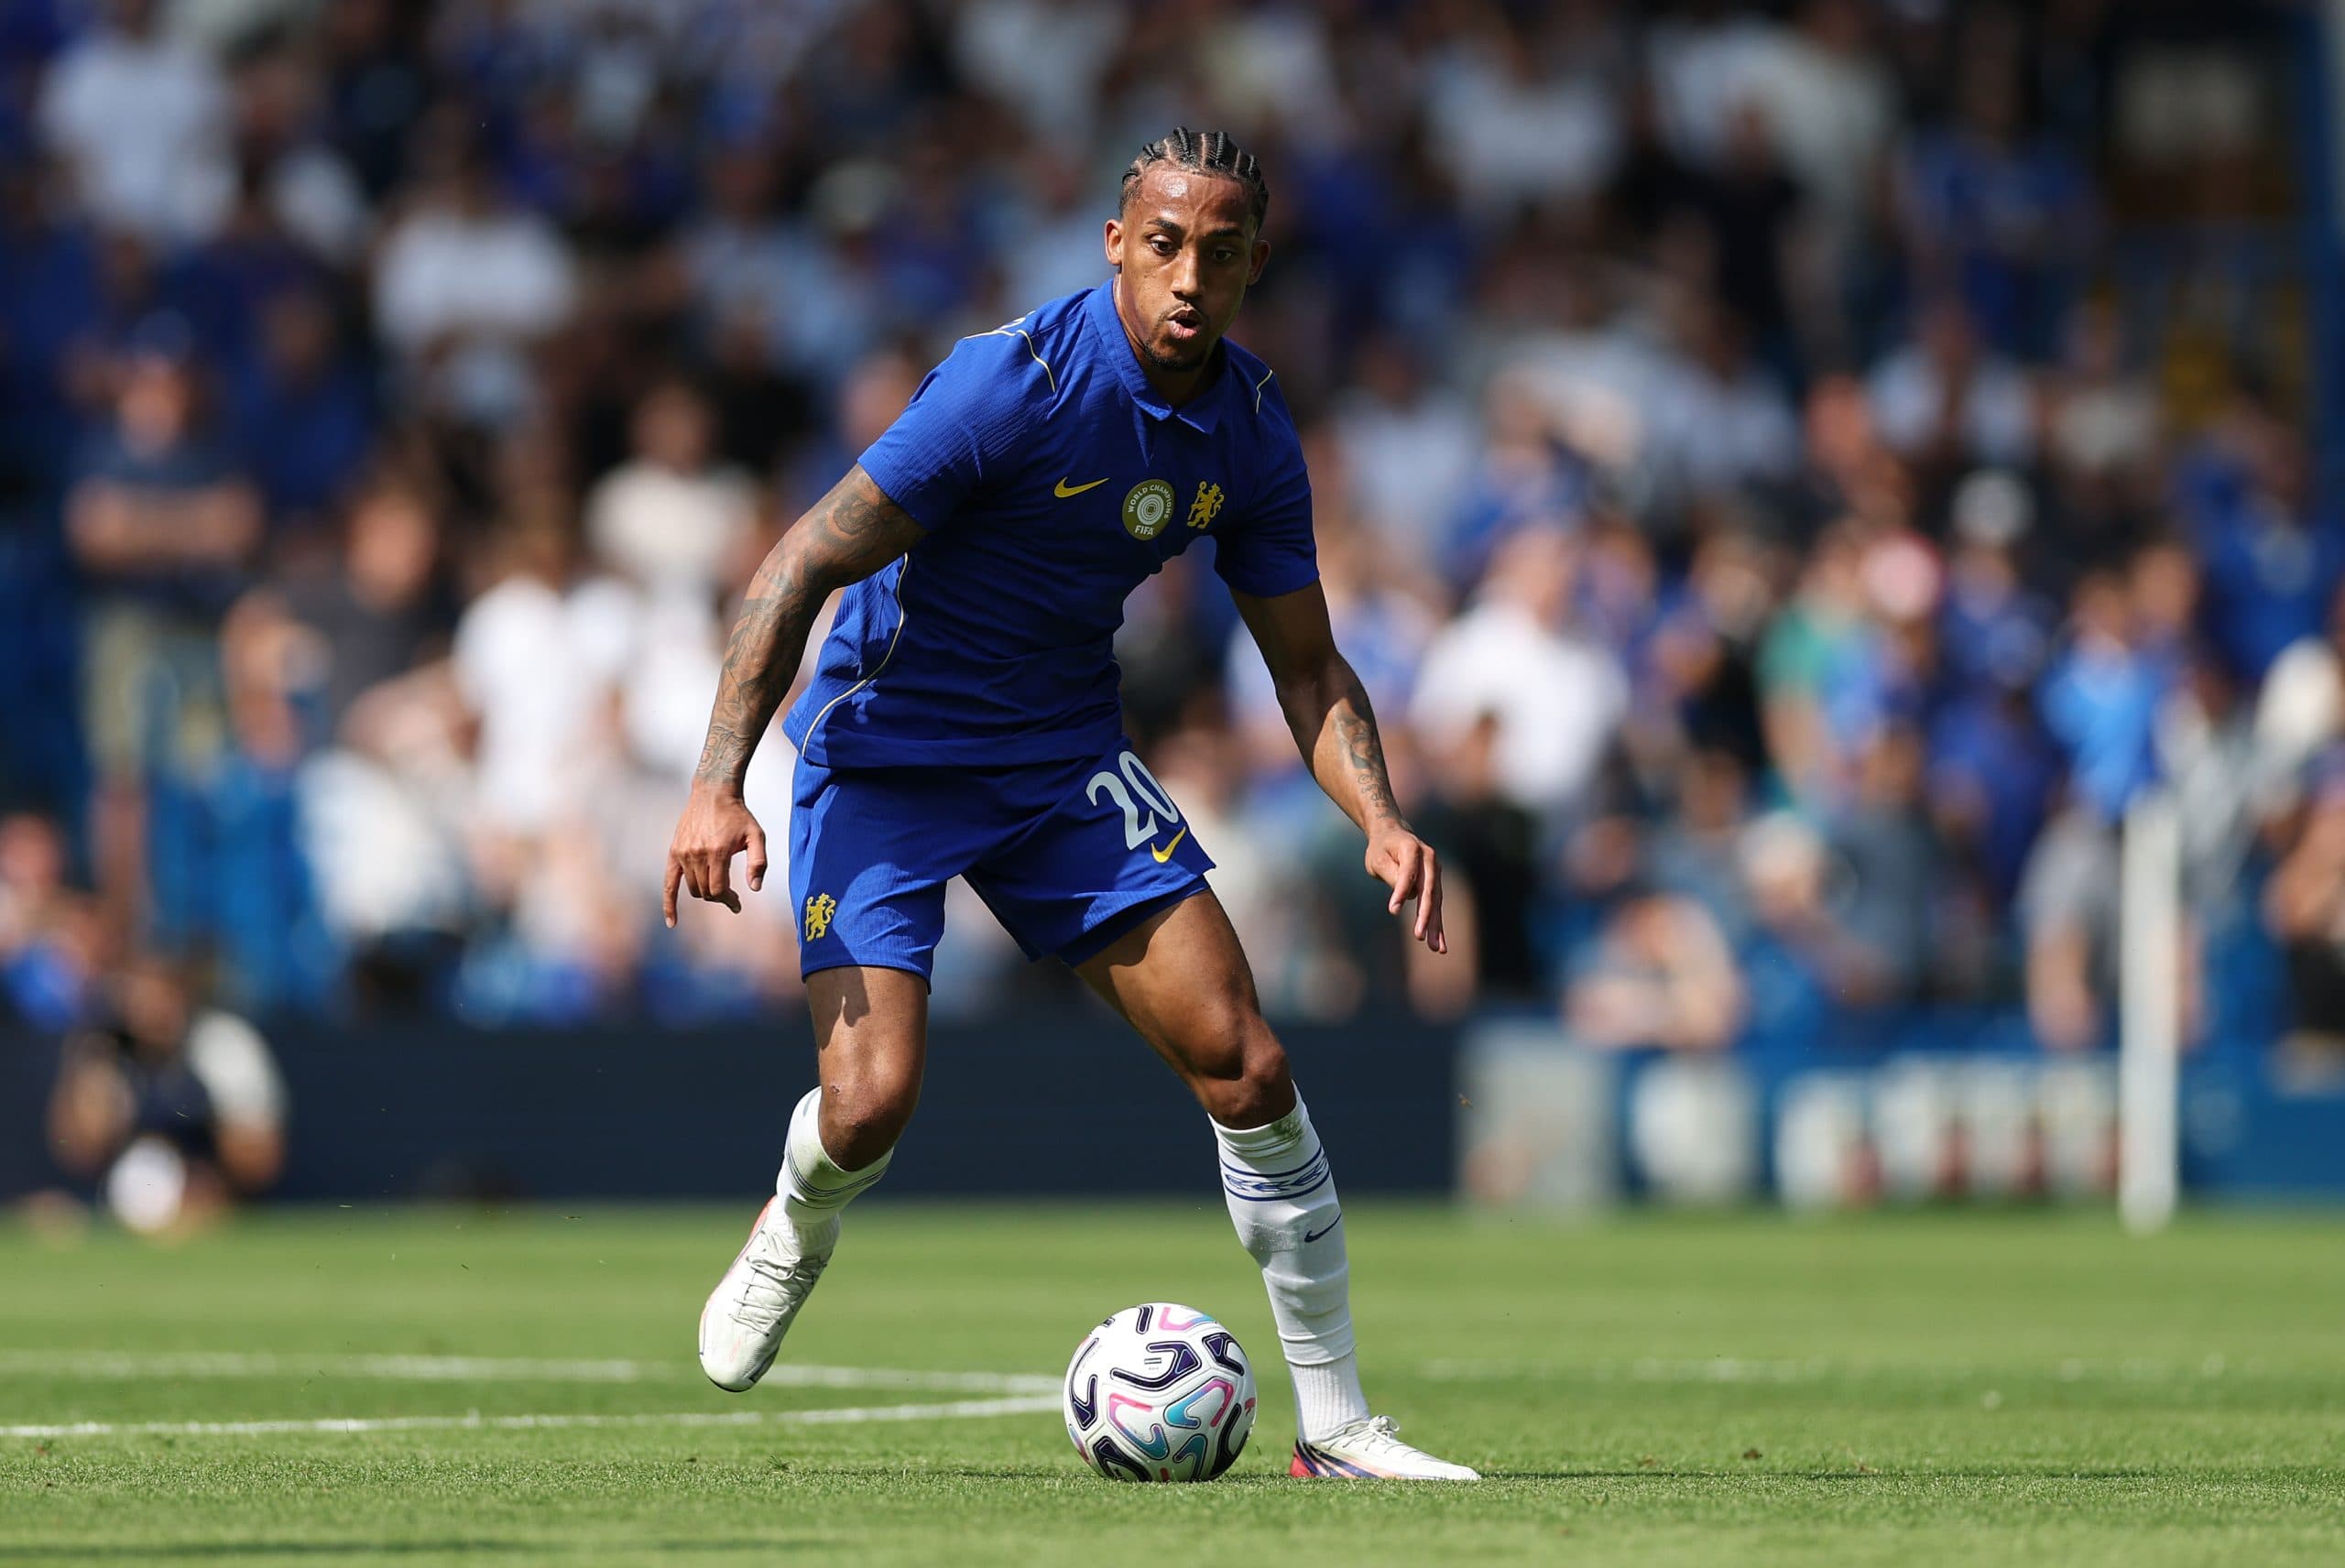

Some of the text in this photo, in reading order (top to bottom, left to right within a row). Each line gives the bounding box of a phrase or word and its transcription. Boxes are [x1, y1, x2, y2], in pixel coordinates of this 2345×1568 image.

[1128, 484, 1172, 519] WORLD CHAMPIONS
[1134, 524, 1154, 536] FIFA
[1085, 750, 1180, 851] 20
